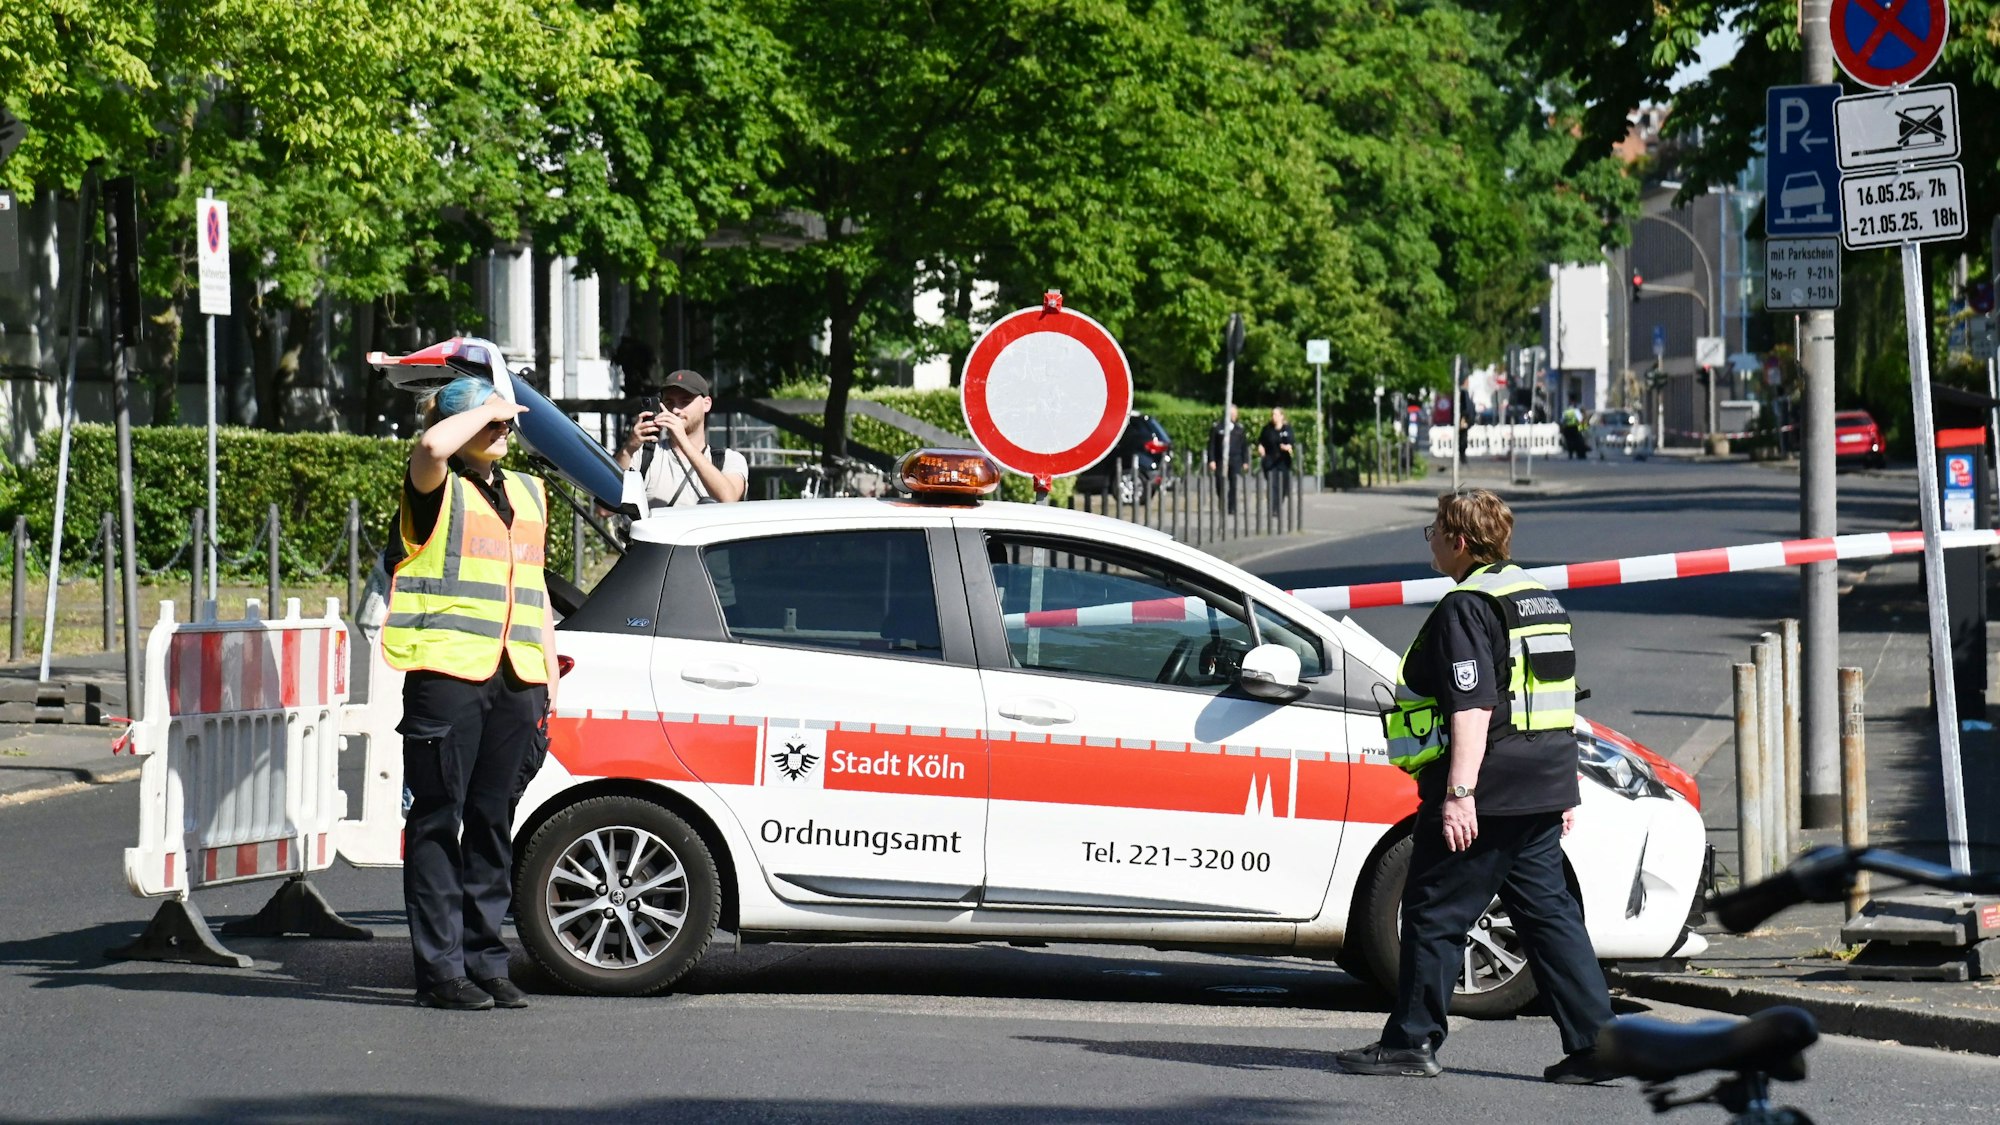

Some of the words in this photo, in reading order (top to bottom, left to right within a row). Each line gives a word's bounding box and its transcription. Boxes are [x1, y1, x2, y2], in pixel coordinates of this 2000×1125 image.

[1780, 97, 1810, 154] P
[1928, 178, 1947, 198] 7h
[1932, 207, 1958, 228] 18h
[1770, 248, 1784, 261] mit
[1788, 246, 1834, 261] Parkschein
[1770, 267, 1796, 280] Mo-Fr
[1770, 287, 1781, 301] Sa
[1362, 747, 1388, 756] HYB
[831, 750, 901, 776] Stadt
[907, 754, 965, 780] Köln
[760, 819, 962, 856] Ordnungsamt
[1082, 841, 1121, 864] Tel.
[1241, 851, 1271, 873] 00
